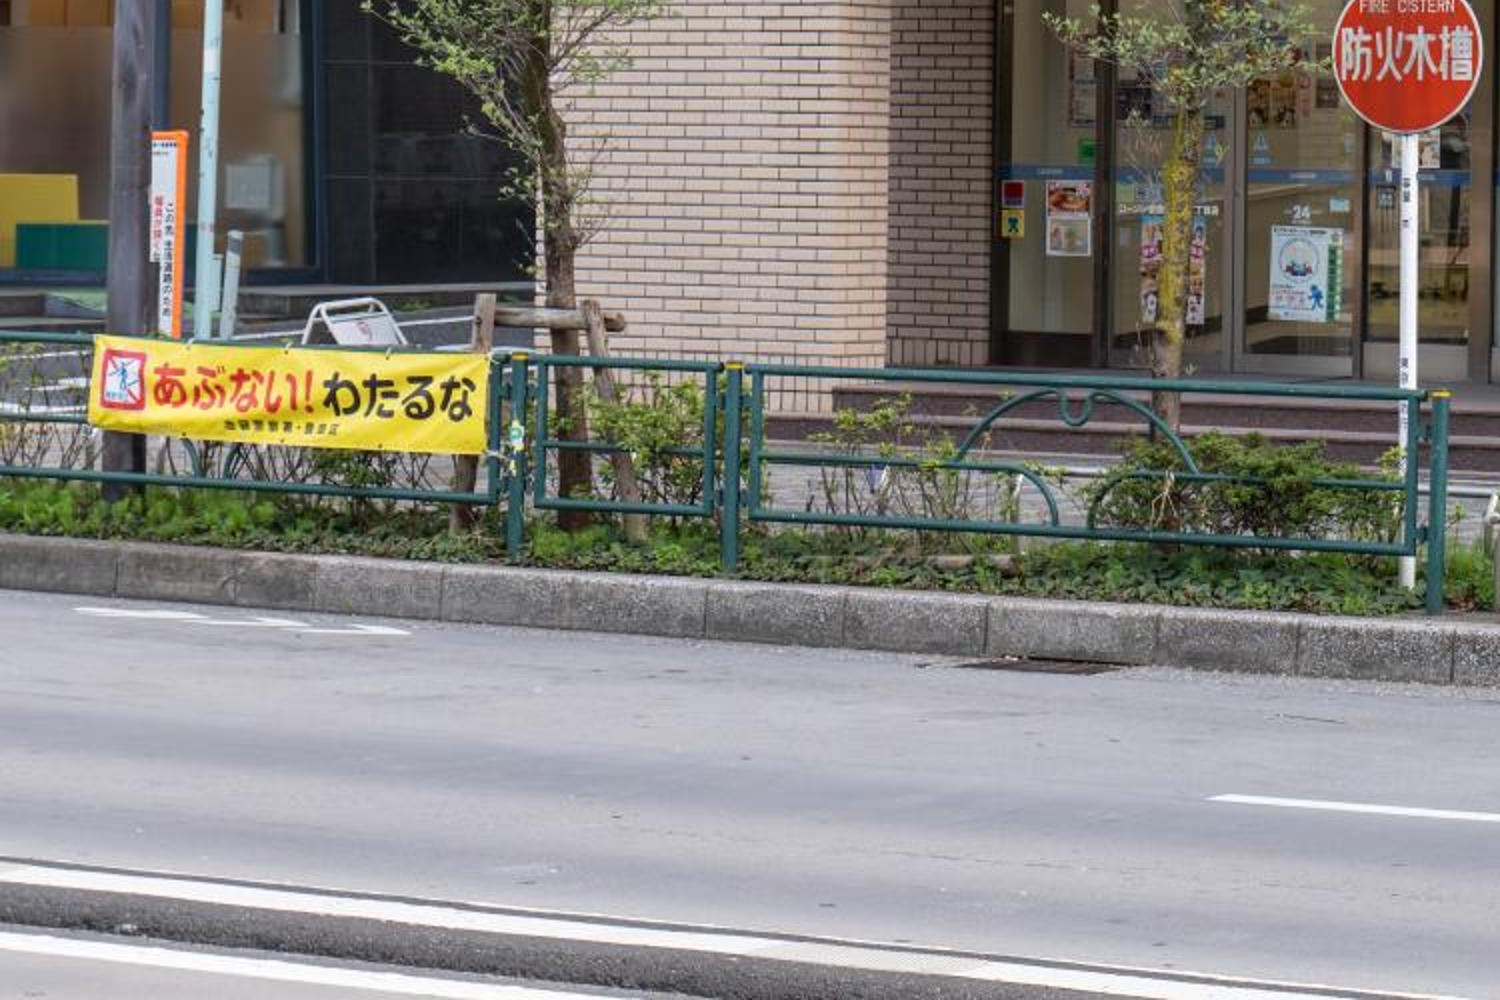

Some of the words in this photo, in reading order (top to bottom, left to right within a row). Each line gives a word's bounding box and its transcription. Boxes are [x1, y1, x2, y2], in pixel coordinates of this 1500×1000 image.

[1341, 25, 1474, 82] 防火水槽
[322, 371, 477, 423] わたるな
